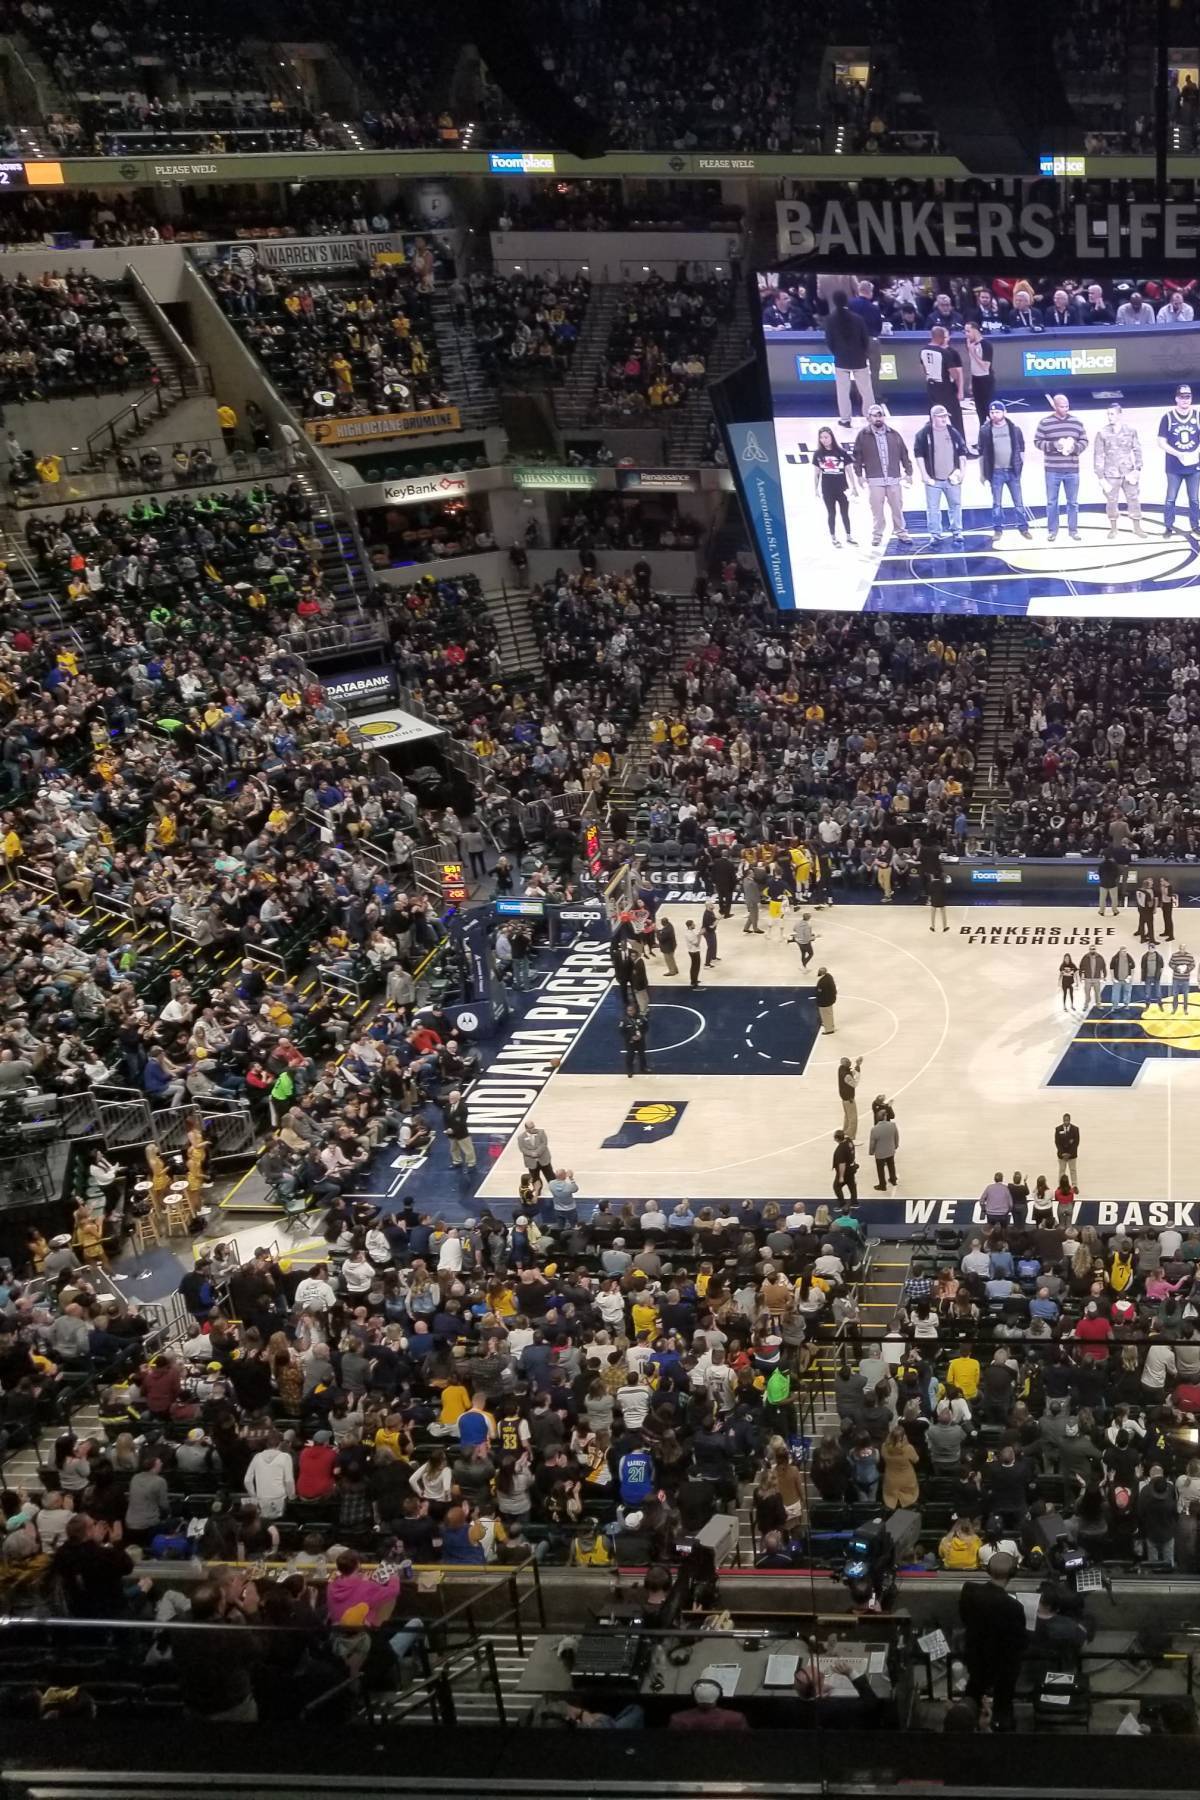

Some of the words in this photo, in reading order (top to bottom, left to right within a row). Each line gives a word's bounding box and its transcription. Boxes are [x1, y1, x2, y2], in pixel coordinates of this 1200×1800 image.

[155, 165, 191, 175] PLEASE
[191, 165, 217, 174] WELC
[492, 156, 554, 174] roomplace
[700, 160, 730, 168] PLEASE
[731, 160, 754, 168] WELC
[1040, 158, 1084, 175] mplace
[775, 199, 1056, 258] BANKERS
[1075, 203, 1198, 258] LIFE
[266, 241, 328, 265] WARREN'S
[1026, 352, 1114, 376] roomplace
[336, 422, 363, 438] HIGH
[364, 419, 402, 435] OCTANE
[402, 412, 453, 429] DRUMLINE
[512, 474, 560, 484] EMBASSY
[560, 474, 598, 484] SUITES
[640, 472, 690, 481] Renaissance
[384, 481, 438, 499] KeyBank
[756, 477, 773, 536] Ascension
[770, 552, 786, 594] Vincent
[326, 675, 390, 695] DATABANK
[559, 912, 600, 920] GEICO
[959, 926, 1062, 936] BANKERS
[1073, 927, 1116, 936] LIFE
[968, 936, 1105, 946] FIELDHOUSE
[465, 1028, 580, 1134] INDIANA
[523, 940, 617, 1020] PACERS
[904, 1200, 958, 1224] WE
[1119, 1266, 1125, 1278] 7
[502, 1434, 517, 1450] 33
[628, 1467, 644, 1482] 21
